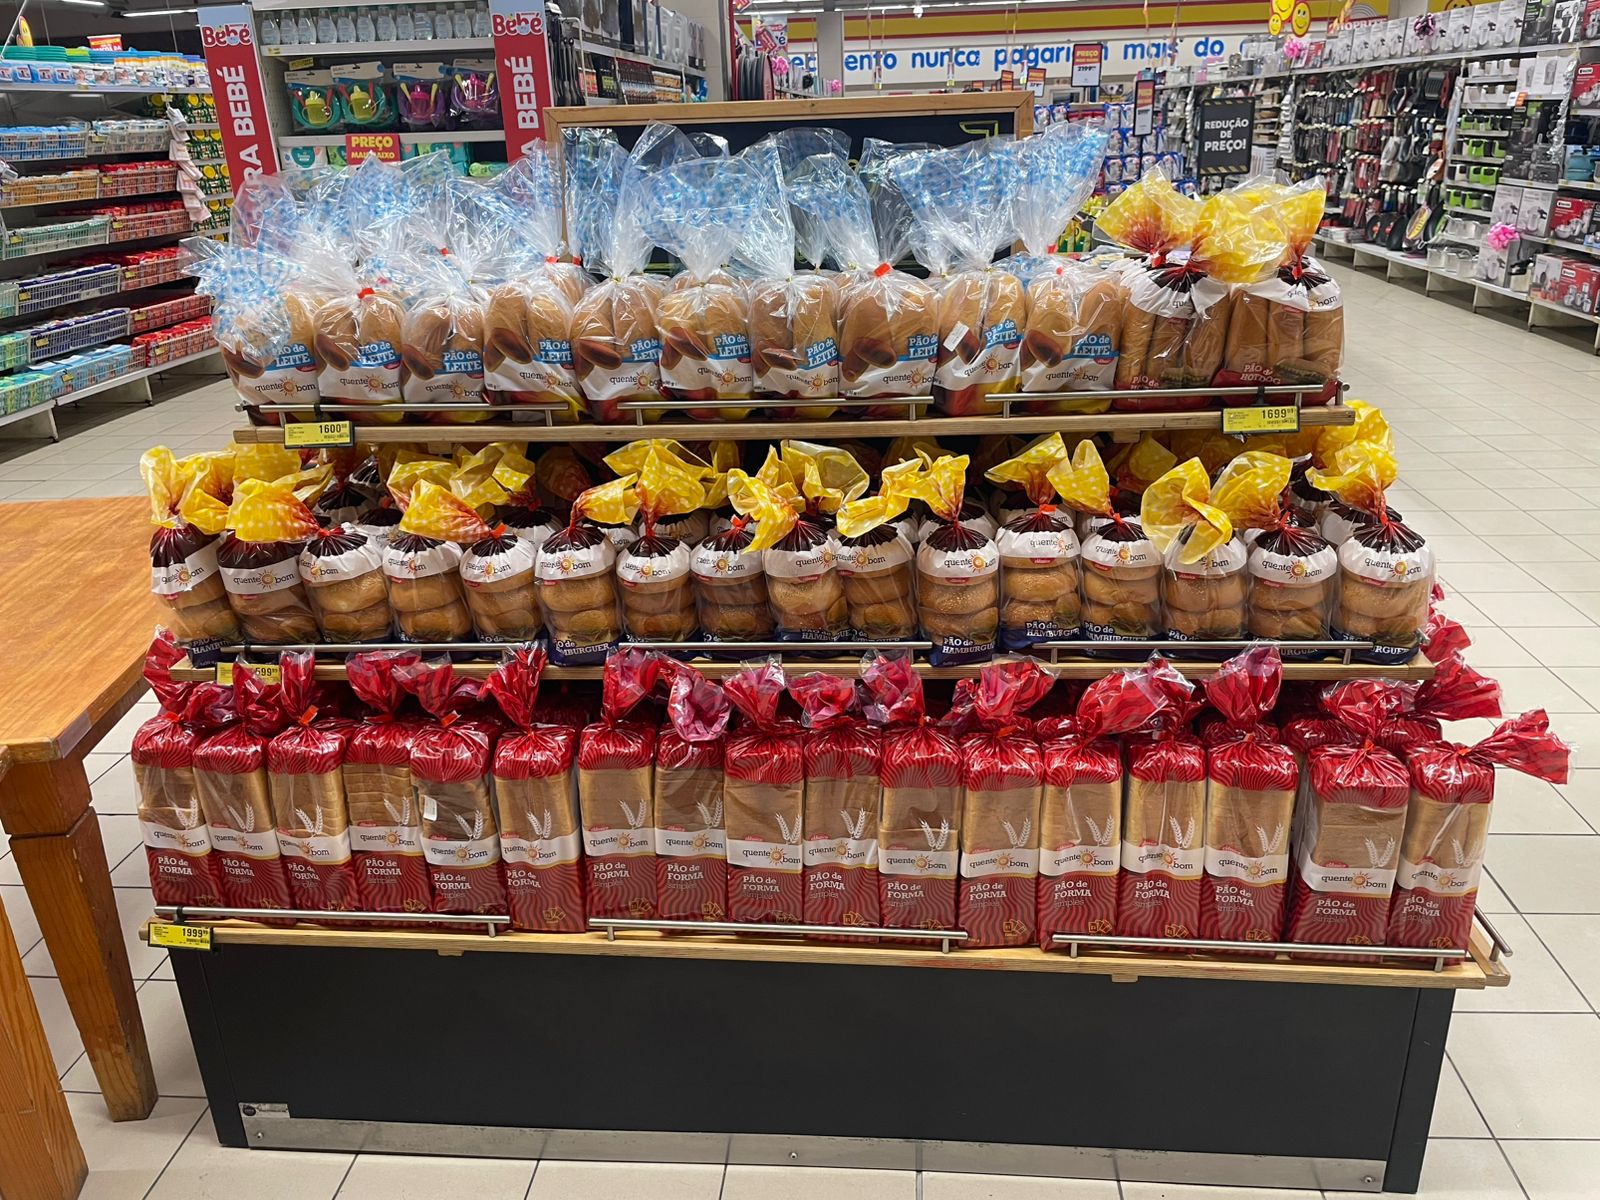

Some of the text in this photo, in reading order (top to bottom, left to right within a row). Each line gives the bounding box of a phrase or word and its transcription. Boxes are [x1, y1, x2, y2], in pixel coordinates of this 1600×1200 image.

[492, 13, 542, 35] Bebé
[202, 25, 251, 46] Bebé
[911, 50, 980, 71] nunca
[1193, 42, 1225, 62] do
[504, 56, 540, 129] BEBÉ
[216, 65, 256, 136] BEBÉ
[1204, 118, 1249, 130] REDUÇÃO
[1220, 130, 1232, 138] DE
[351, 137, 393, 152] PREÇO
[1204, 139, 1246, 153] PREÇO!
[1005, 320, 1015, 329] de
[715, 335, 735, 346] PÃO
[909, 336, 928, 346] PÃO
[1099, 336, 1109, 344] de
[292, 345, 304, 353] de
[380, 342, 391, 350] de
[540, 340, 571, 350] PÃO de
[631, 338, 658, 352] PÃO de
[807, 339, 834, 356] PÃO de
[719, 345, 749, 356] LEITE
[1074, 345, 1110, 355] LEITE
[276, 353, 310, 366] LEITE
[362, 349, 396, 364] LEITE
[444, 351, 465, 361] PÃO
[808, 347, 837, 367] LEITE
[445, 361, 482, 372] LEITE
[1244, 363, 1273, 376] PÃO de
[610, 375, 636, 384] quente
[883, 374, 911, 384] quente
[1046, 372, 1073, 380] quente
[340, 378, 368, 386] quente
[1149, 377, 1158, 386] de
[255, 382, 282, 392] quente
[1262, 409, 1287, 419] 1699
[319, 424, 342, 434] 1600
[868, 556, 885, 564] bom
[1130, 553, 1147, 561] bom
[573, 561, 591, 569] bom
[796, 557, 823, 567] quente
[944, 558, 971, 567] quente
[1262, 560, 1291, 571] quente
[320, 567, 338, 575] bom
[494, 564, 511, 573] bom
[728, 563, 745, 571] bom
[275, 573, 294, 583] bom
[1085, 621, 1102, 634] PÃO
[1169, 630, 1187, 641] PÃO
[944, 637, 962, 646] PÃO
[360, 834, 415, 846] quente bom
[590, 837, 648, 847] quente bom
[705, 840, 723, 848] bom
[311, 847, 329, 856] bom
[431, 847, 488, 859] quente bom
[743, 849, 770, 857] quente
[809, 847, 864, 859] quente bom
[158, 856, 177, 865] PÃO
[222, 858, 250, 868] PÃO de
[366, 858, 384, 867] PÃO
[887, 857, 915, 865] quente
[970, 857, 1028, 868] quente bom
[1054, 855, 1113, 866] quente bom
[1173, 861, 1193, 869] bom
[1219, 860, 1249, 870] quente
[159, 866, 193, 876] FORMA
[225, 867, 255, 876] FORMA
[288, 863, 315, 872] PÃO de
[593, 862, 613, 872] PÃO
[667, 864, 687, 872] PÃO
[367, 868, 402, 876] FORMA
[507, 870, 536, 879] PÃO de
[594, 870, 630, 879] FORMA
[668, 872, 703, 881] FORMA
[810, 872, 842, 881] PÃO de
[433, 873, 466, 882] PÃO de
[743, 875, 776, 884] PÃO de
[1321, 875, 1387, 889] quente bom
[436, 882, 472, 890] FORMA
[508, 879, 541, 888] FORMA
[743, 884, 780, 892] FORMA
[810, 881, 845, 890] FORMA
[888, 881, 908, 890] PÃO
[970, 883, 990, 892] PÃO
[1055, 881, 1074, 890] PÃO
[1136, 880, 1167, 890] PÃO de
[1135, 889, 1170, 898] FORMA
[1216, 886, 1237, 894] PÃO
[888, 891, 924, 899] FORMA
[970, 891, 1006, 900] FORMA
[1055, 890, 1091, 900] FORMA
[1215, 895, 1254, 907] FORMA
[1317, 899, 1340, 907] PÃO
[1426, 900, 1439, 908] de
[1316, 907, 1357, 916] FORMA
[1403, 906, 1440, 917] FORMA
[182, 928, 203, 938] 1999
